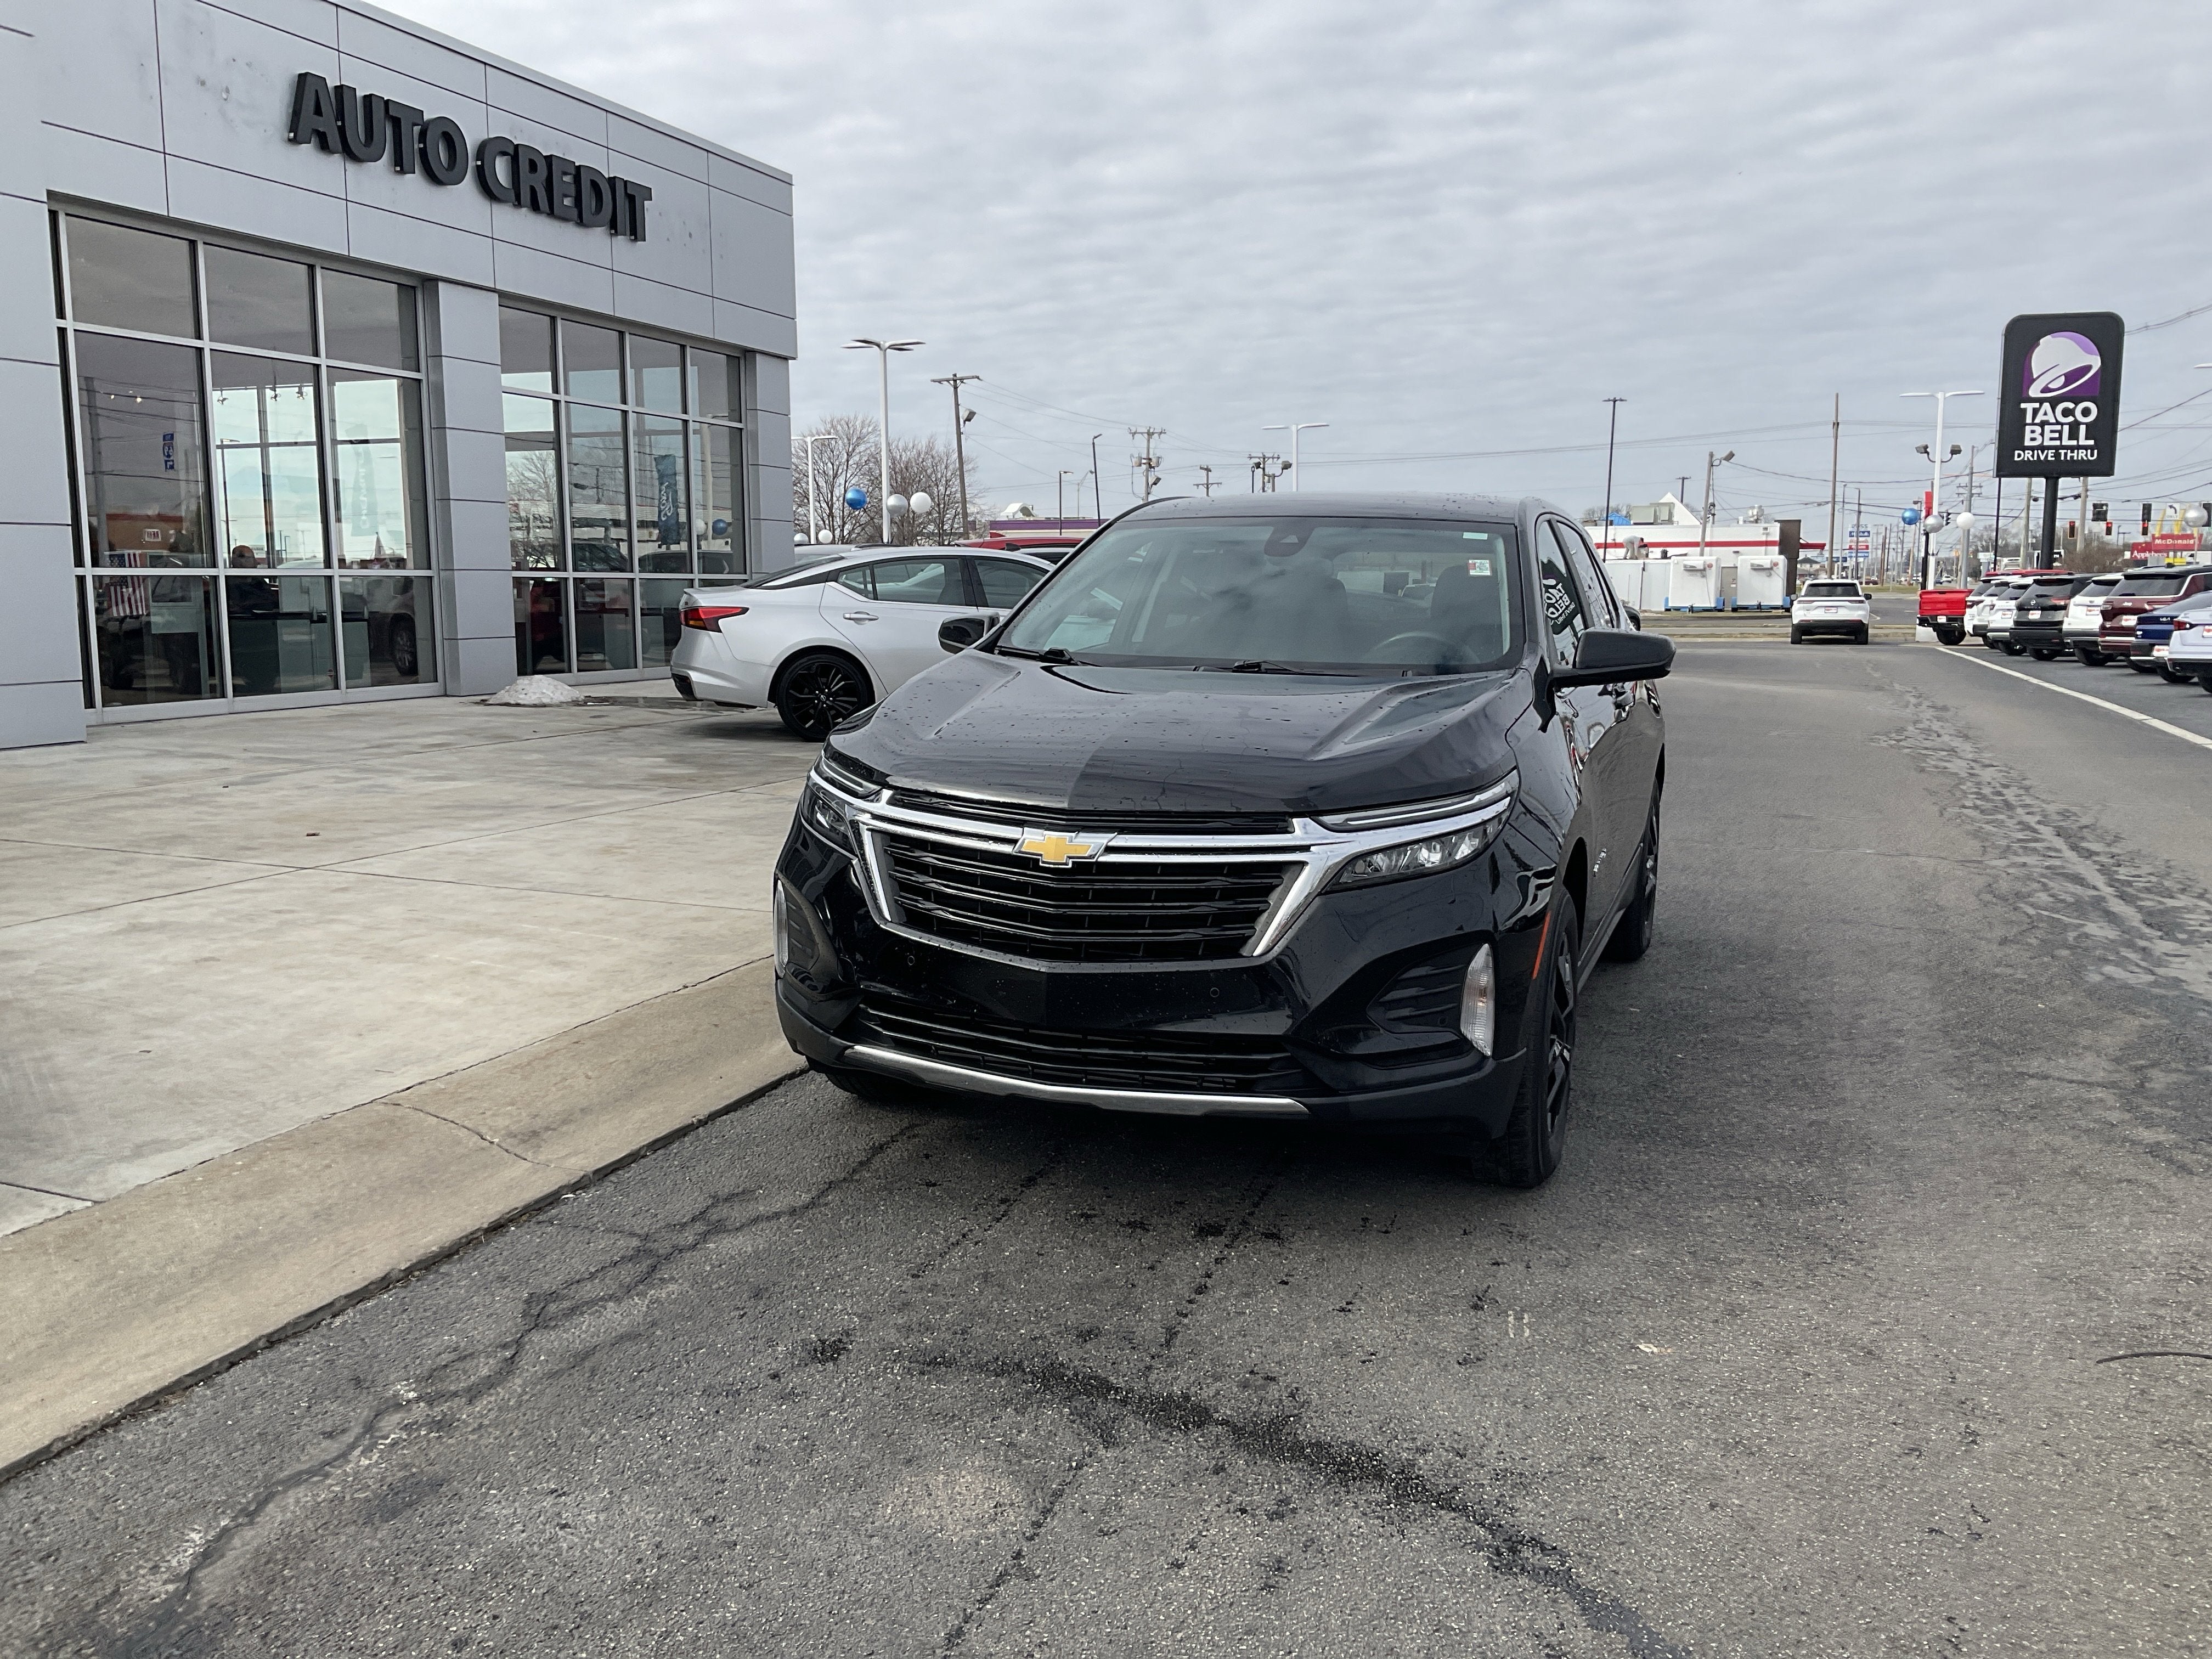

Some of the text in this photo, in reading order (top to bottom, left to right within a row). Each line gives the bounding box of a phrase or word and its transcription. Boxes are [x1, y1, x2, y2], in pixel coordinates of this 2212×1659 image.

[288, 72, 652, 242] AUTO CREDIT
[2020, 401, 2098, 424] TACO
[2024, 424, 2095, 446] BELL
[2014, 449, 2098, 461] DRIVE THRU
[2132, 550, 2168, 558] Applebee's
